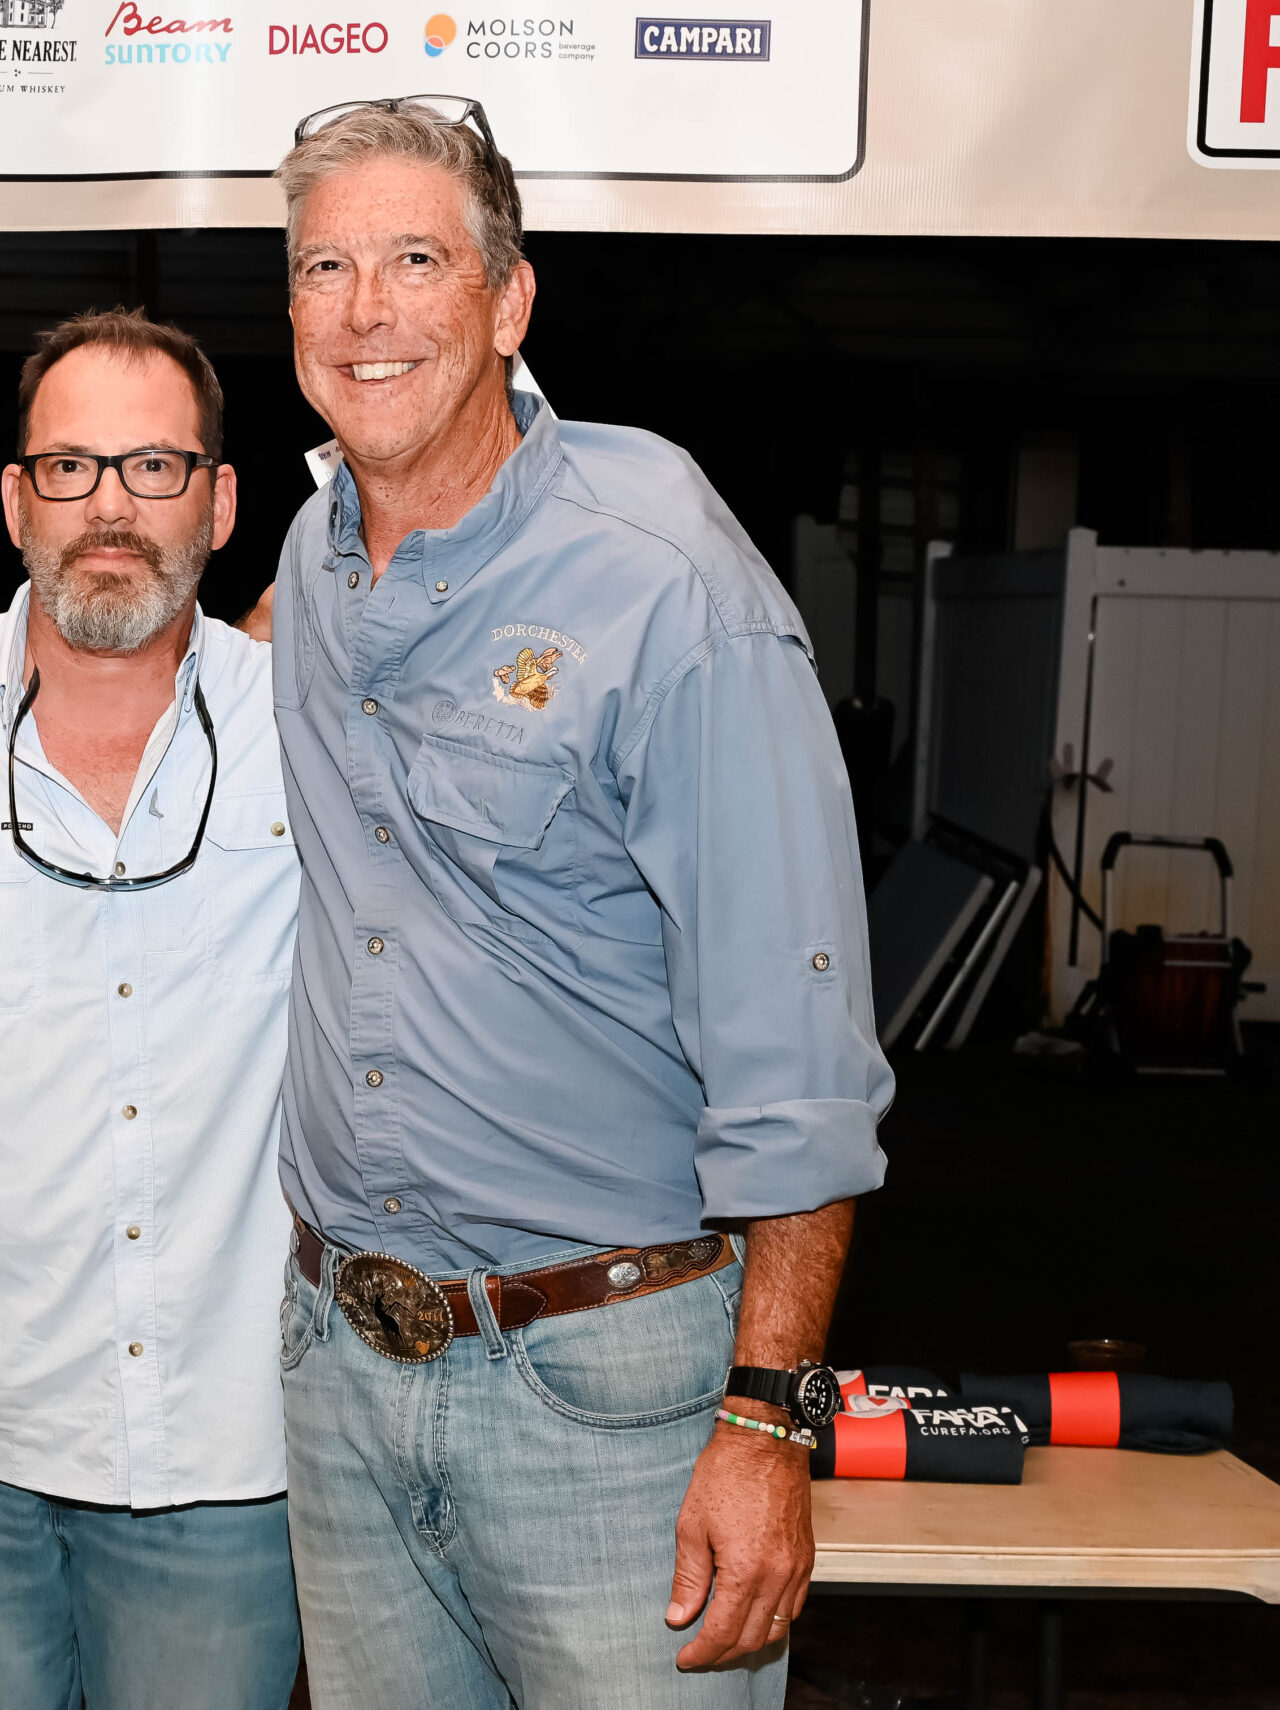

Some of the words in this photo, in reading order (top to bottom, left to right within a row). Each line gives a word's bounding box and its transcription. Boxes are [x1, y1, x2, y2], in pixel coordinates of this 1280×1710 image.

[105, 1, 233, 37] Beam
[467, 19, 574, 36] MOLSON
[269, 22, 389, 55] DIAGEO
[558, 42, 596, 51] beverage
[643, 25, 762, 54] CAMPARI
[11, 40, 77, 62] NEAREST
[466, 41, 553, 59] COORS
[558, 52, 595, 61] company
[20, 85, 66, 94] WHISKEY
[491, 623, 589, 665] DORCHESTER
[454, 711, 524, 744] BERETTA
[920, 1425, 1011, 1437] CUREFA.ORG
